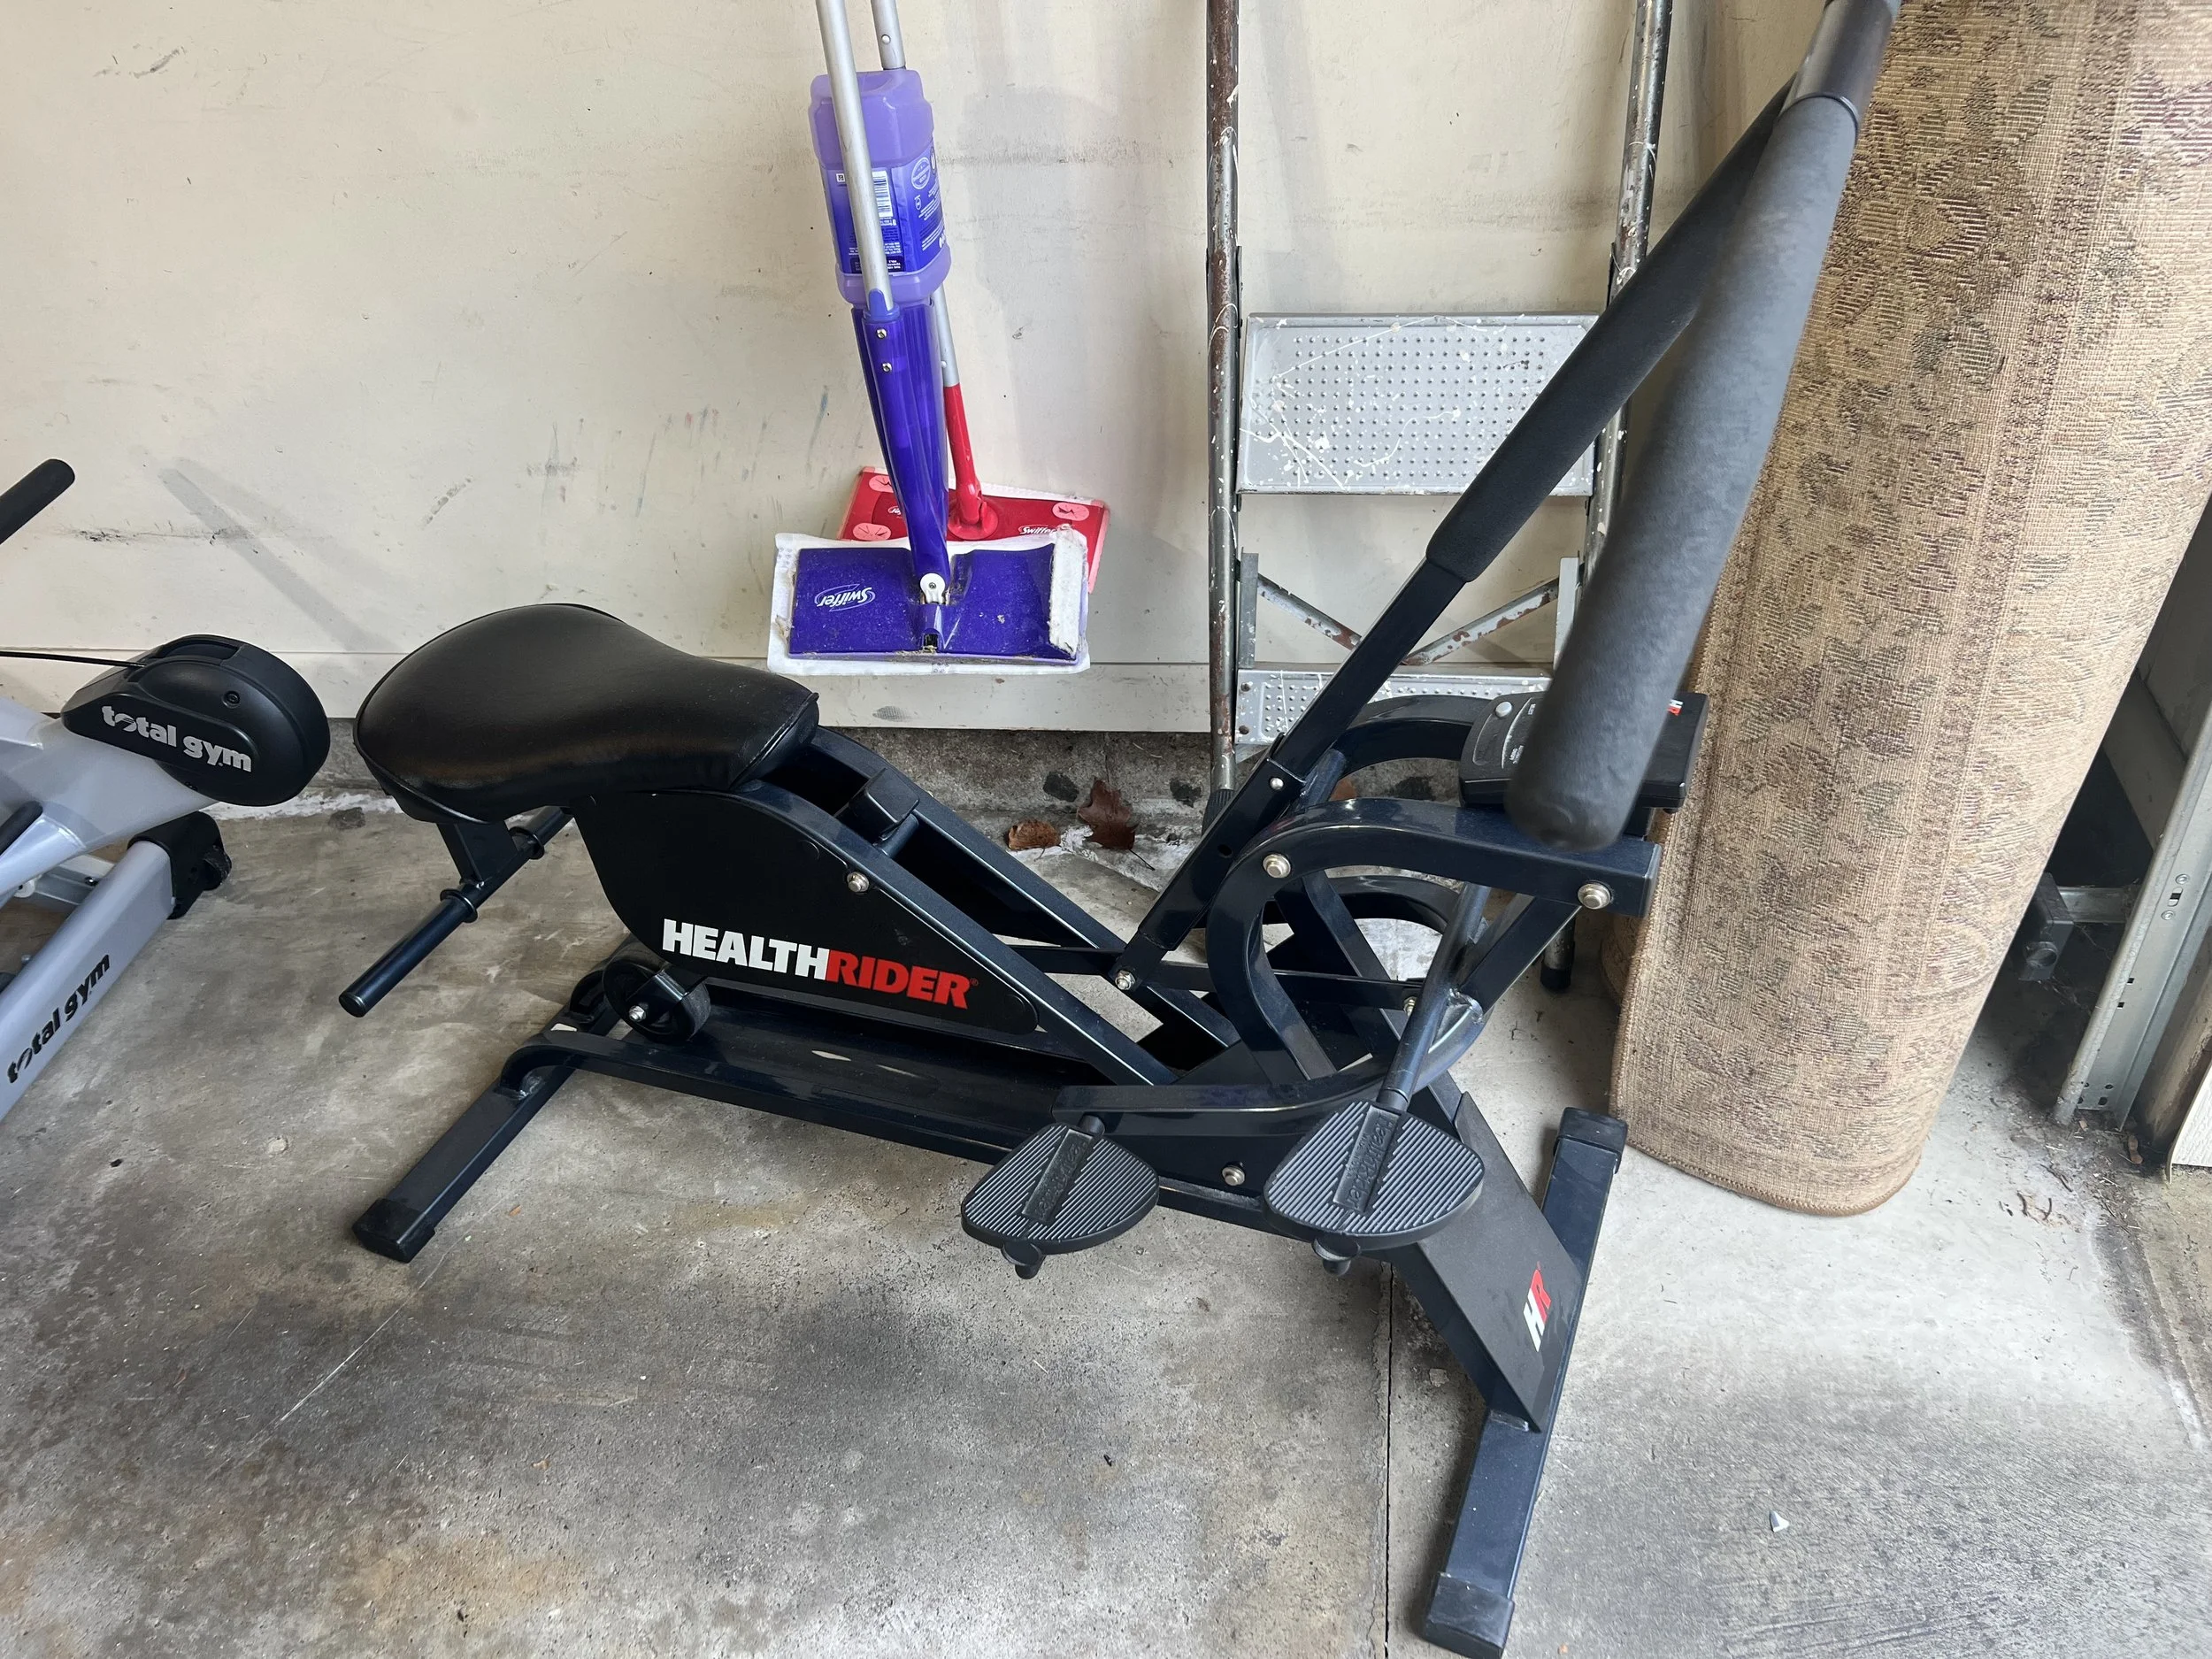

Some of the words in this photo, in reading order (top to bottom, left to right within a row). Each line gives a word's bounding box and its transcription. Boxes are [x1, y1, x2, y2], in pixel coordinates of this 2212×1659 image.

[817, 587, 872, 608] Swiffer
[101, 704, 177, 746] total
[182, 733, 253, 772] gym
[7, 1009, 62, 1083] total
[64, 953, 111, 1022] gym
[1523, 1270, 1552, 1352] HR
